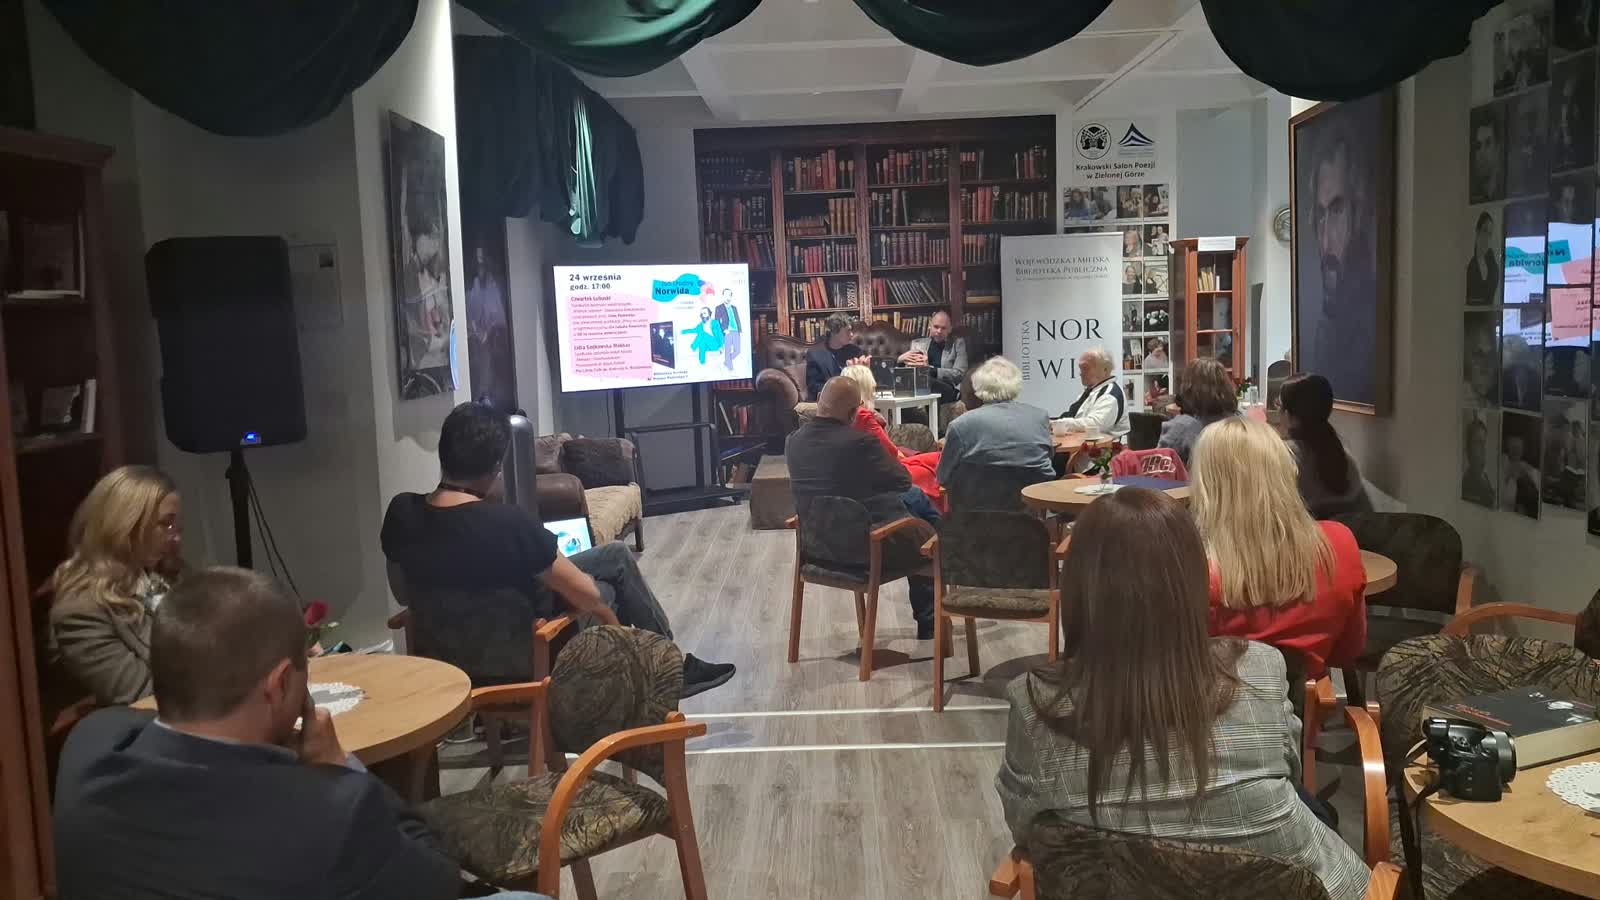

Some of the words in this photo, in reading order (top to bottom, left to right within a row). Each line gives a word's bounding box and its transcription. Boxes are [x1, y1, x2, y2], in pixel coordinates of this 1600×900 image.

[1113, 162, 1133, 170] Salon
[1134, 161, 1156, 170] Poezji
[1124, 170, 1145, 178] Górze
[569, 273, 581, 282] 24
[582, 272, 622, 281] września
[569, 283, 590, 291] godz.
[591, 282, 611, 290] 17:00
[655, 287, 690, 295] Norwida
[1036, 318, 1103, 341] NOR
[1021, 320, 1031, 381] BIBLIOTEKA
[1037, 358, 1077, 379] WI
